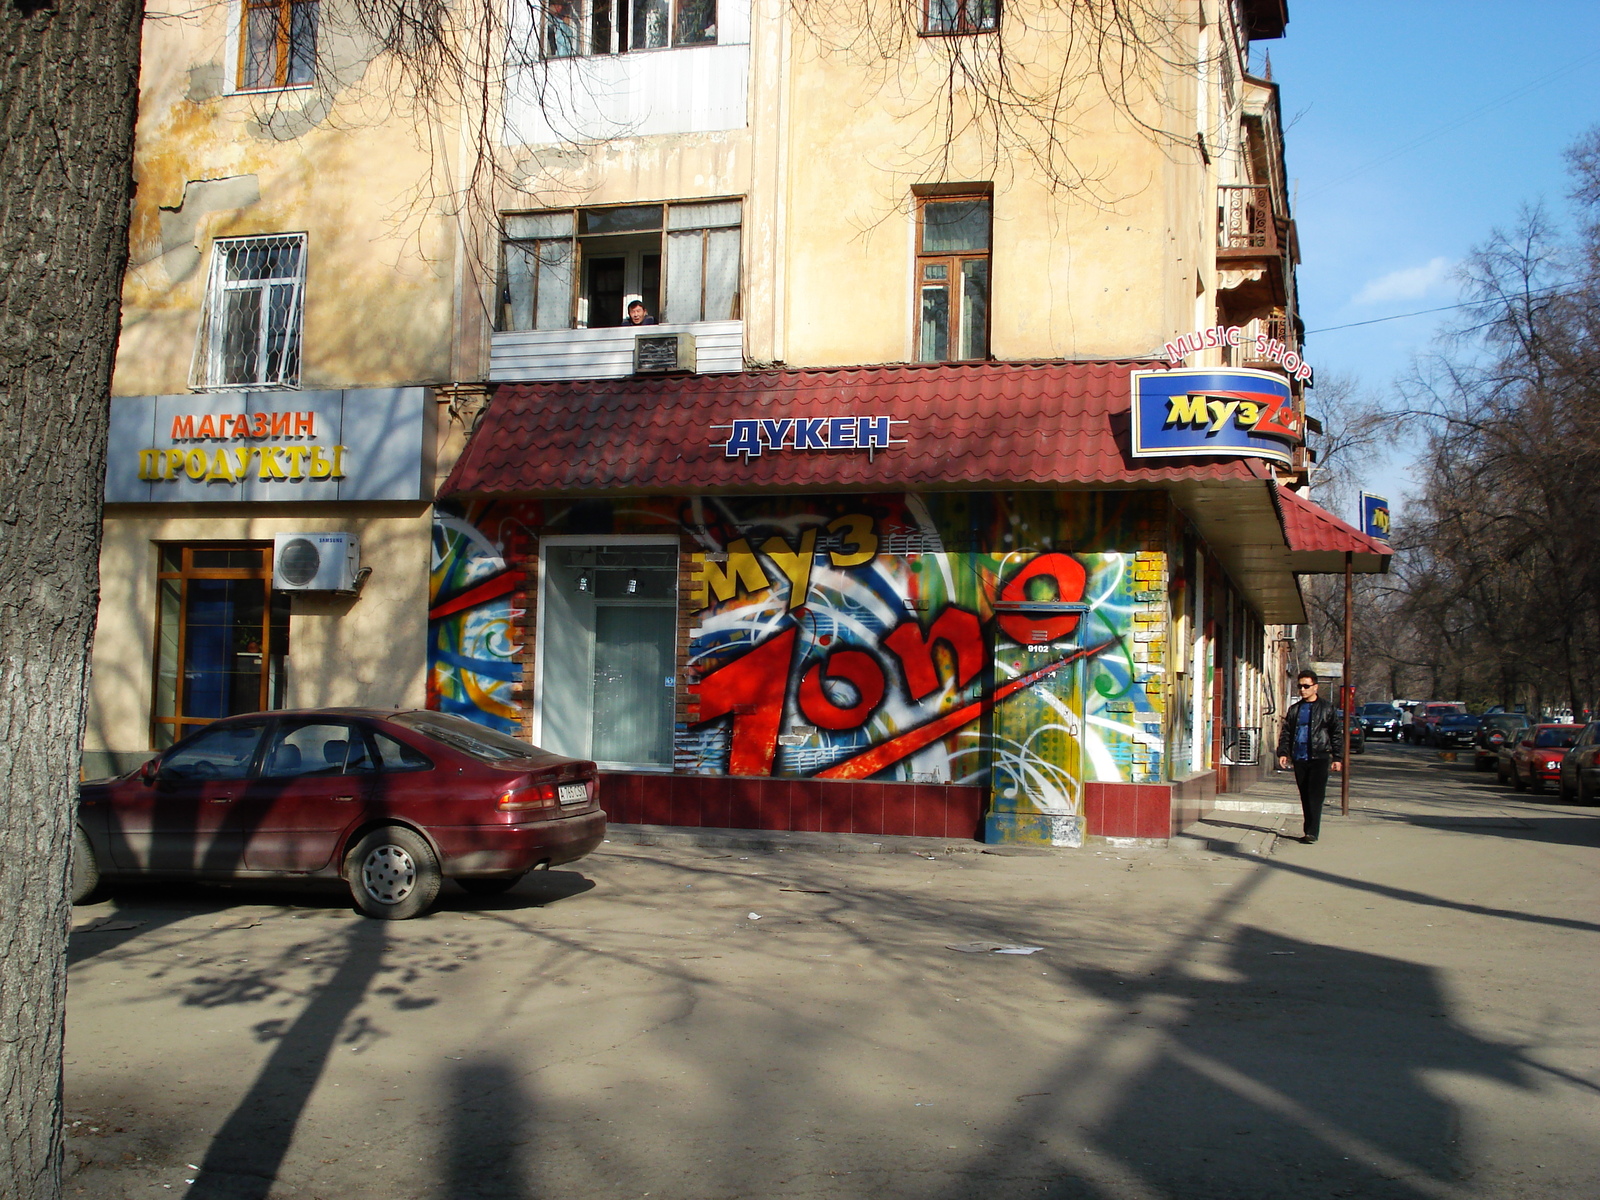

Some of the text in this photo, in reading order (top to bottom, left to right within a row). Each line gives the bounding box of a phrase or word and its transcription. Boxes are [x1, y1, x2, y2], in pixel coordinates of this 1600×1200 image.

[1164, 326, 1313, 385] MUSIC SHOP
[171, 411, 317, 440] МАГАЗИН
[138, 444, 347, 484] ПРОДУКТЫ
[1027, 645, 1049, 653] 9102
